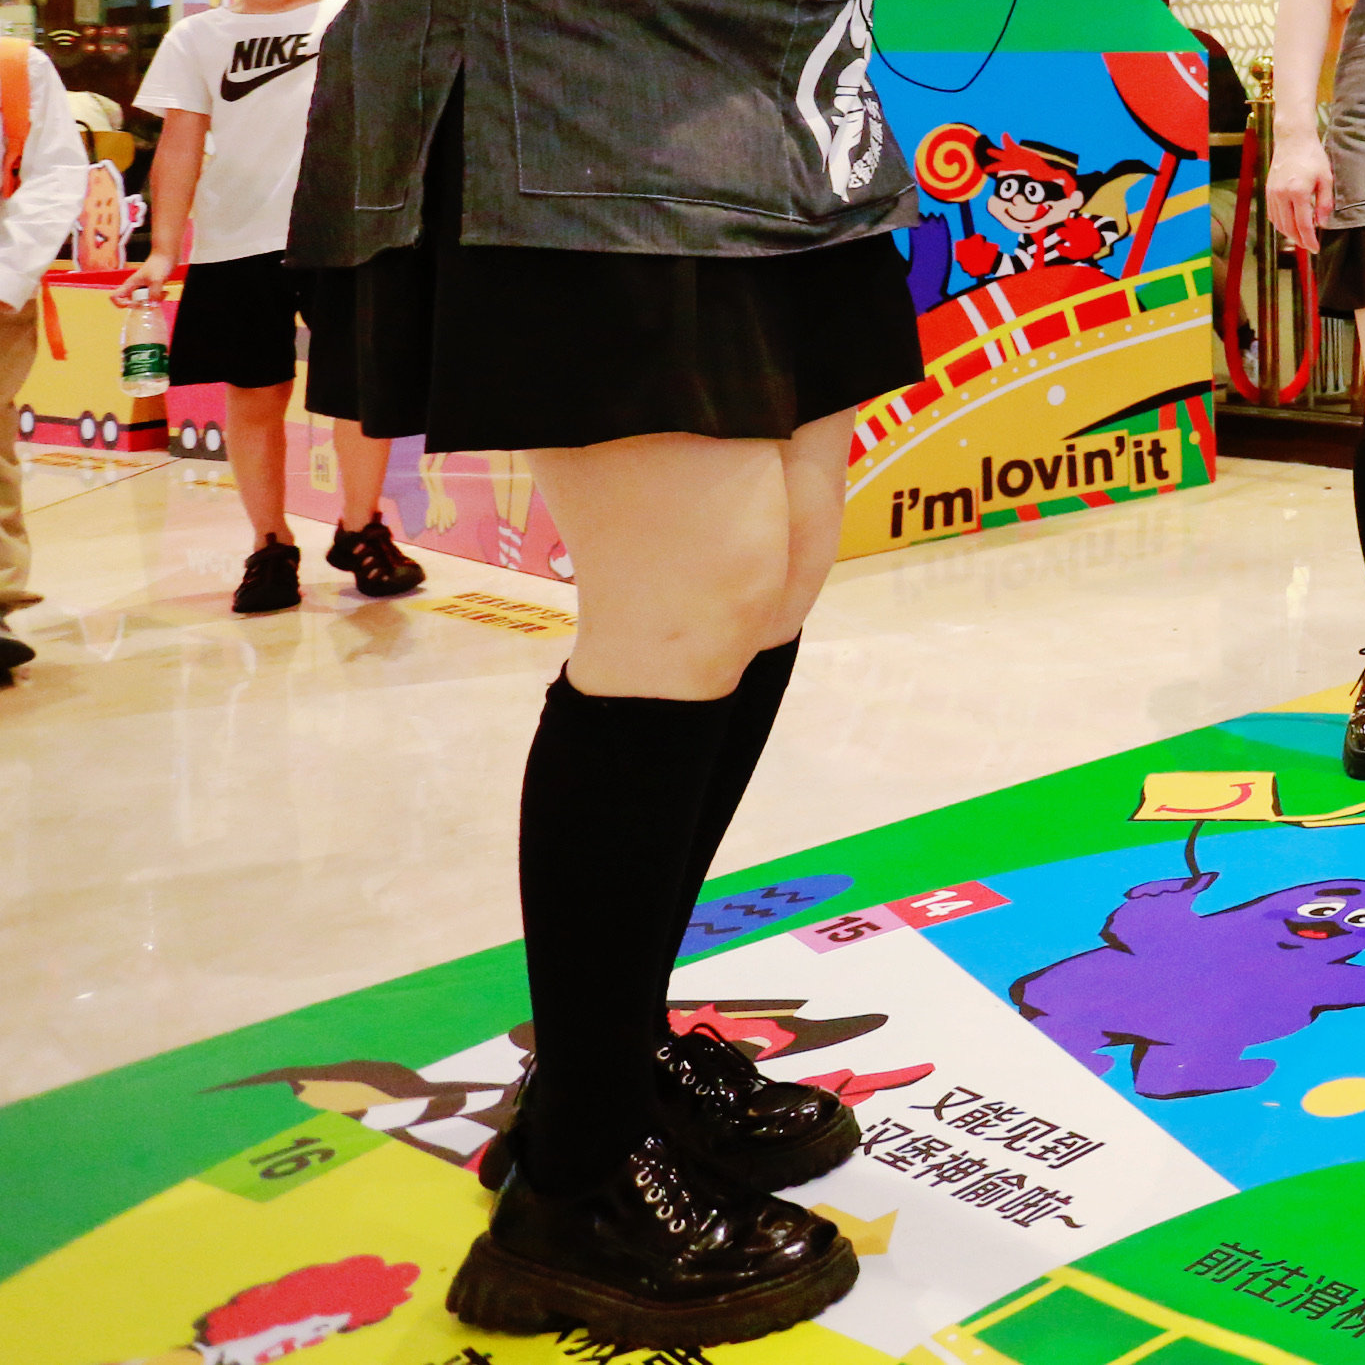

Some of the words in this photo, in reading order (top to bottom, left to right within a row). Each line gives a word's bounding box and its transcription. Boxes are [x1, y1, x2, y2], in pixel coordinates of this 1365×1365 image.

[229, 32, 312, 74] NIKE
[890, 487, 974, 539] i'm
[981, 435, 1127, 502] lovin'
[1132, 438, 1170, 485] it
[905, 888, 957, 919] 14
[814, 915, 883, 945] 15
[907, 1085, 1107, 1170] 又能见到
[249, 1136, 337, 1184] 16
